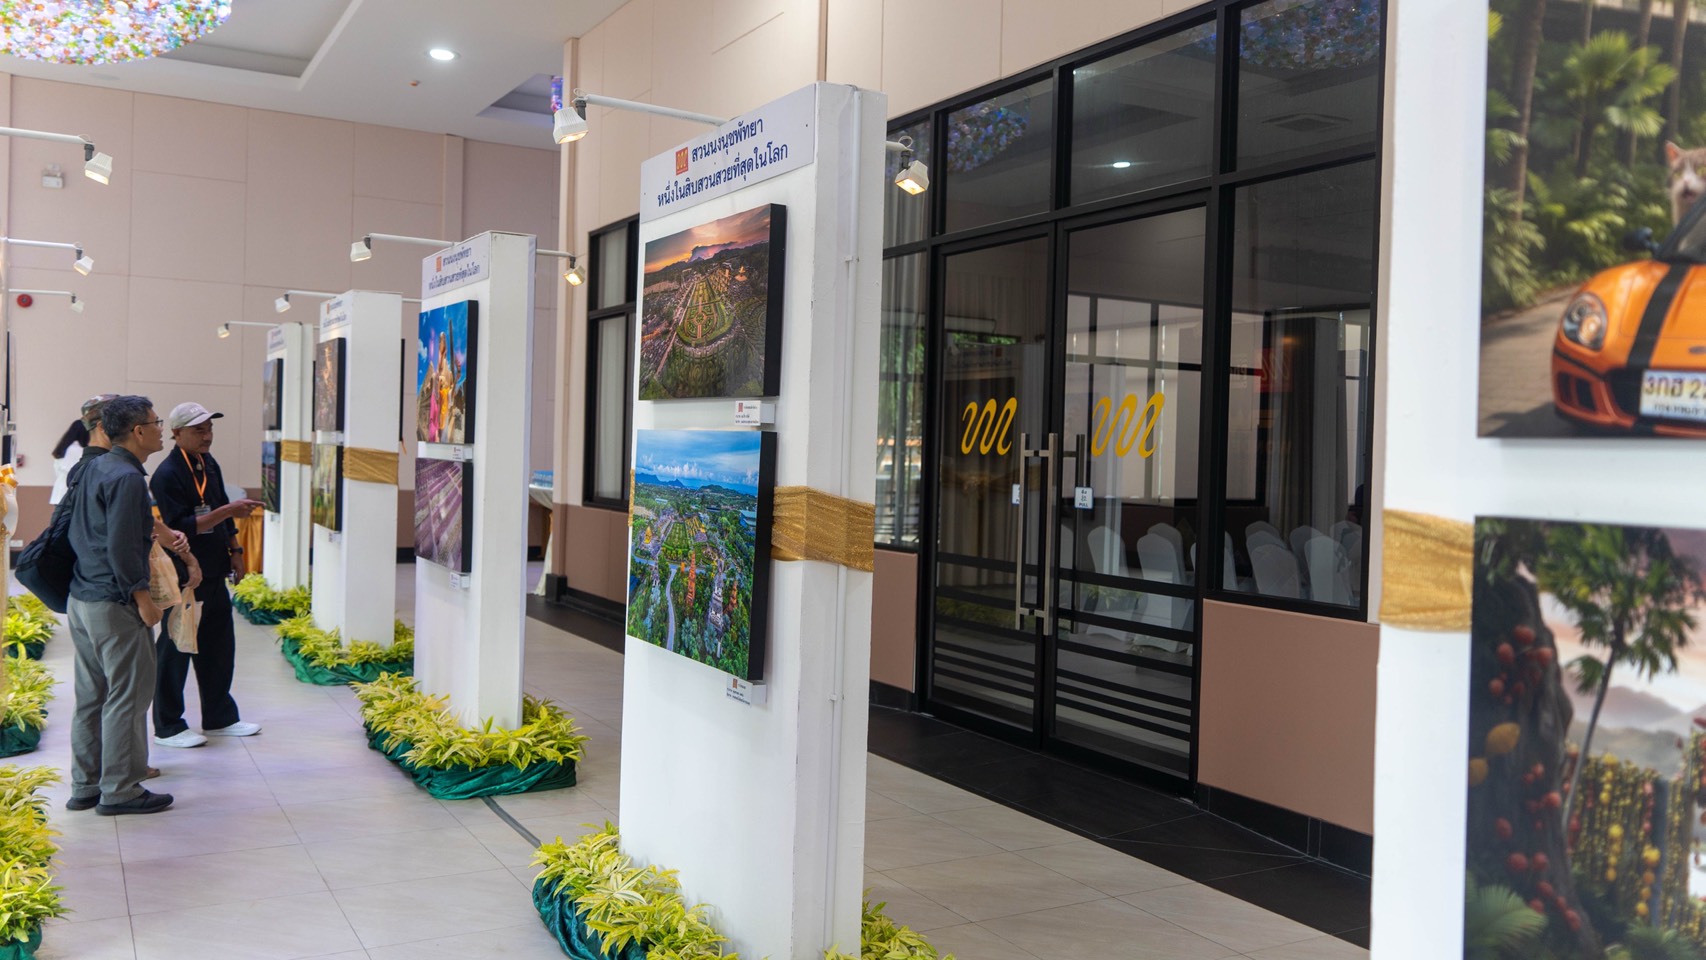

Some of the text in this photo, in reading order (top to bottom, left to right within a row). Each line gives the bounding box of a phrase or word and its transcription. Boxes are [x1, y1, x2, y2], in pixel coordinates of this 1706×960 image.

[691, 118, 763, 163] สวนนงนุชพัทยา
[657, 141, 788, 207] หนึ่งในสิบสวนสวยที่สุดในโลก
[1689, 378, 1706, 399] 2
